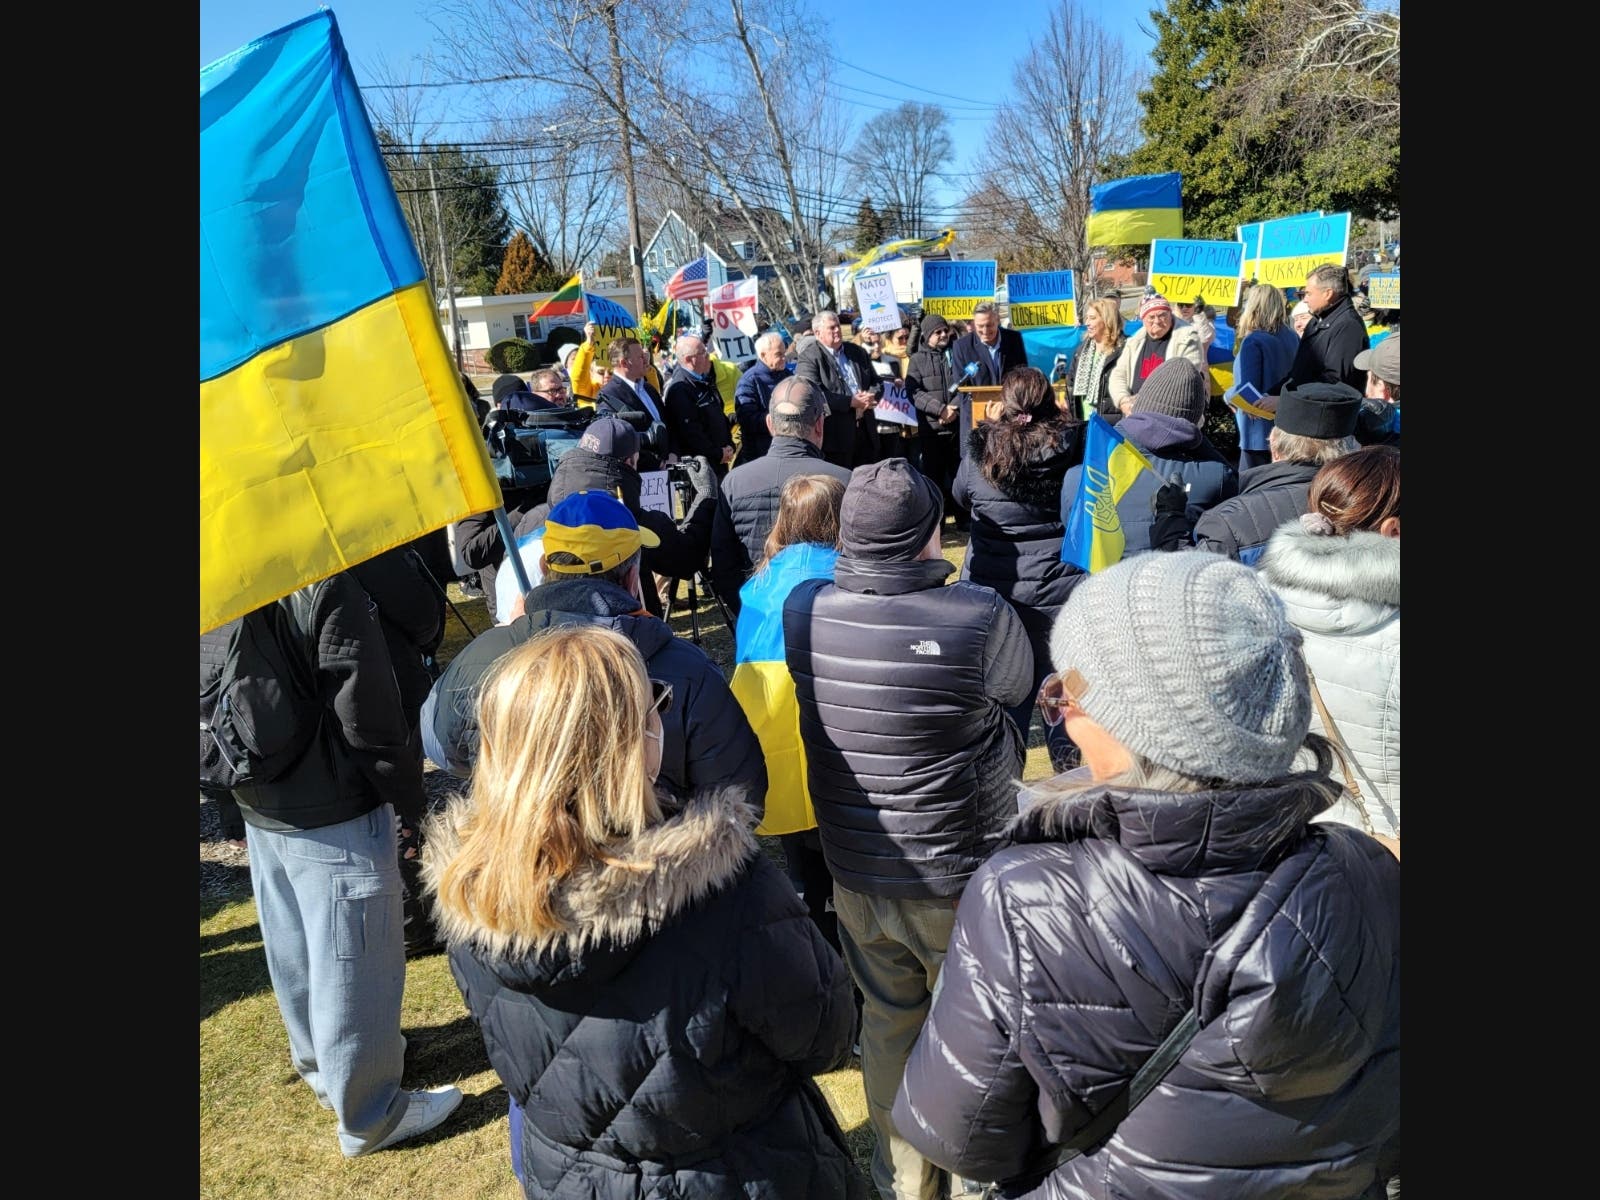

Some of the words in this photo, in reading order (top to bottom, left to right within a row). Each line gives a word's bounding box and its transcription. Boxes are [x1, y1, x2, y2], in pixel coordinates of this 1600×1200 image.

[1269, 222, 1331, 249] STAND
[1161, 245, 1203, 268] STOP
[1204, 246, 1242, 269] PUTIN
[926, 265, 952, 291] STOP
[954, 265, 996, 291] RUSSIAN
[1265, 257, 1330, 281] UKRAIN
[860, 278, 887, 290] NATO
[1008, 274, 1032, 297] SAVE
[1032, 272, 1071, 296] UKRAINE
[1160, 275, 1195, 297] STOP
[925, 299, 974, 316] AGGRESSOR
[1010, 306, 1035, 326] CLOSE
[1034, 305, 1050, 325] THE
[1051, 303, 1069, 325] SKY
[595, 312, 636, 339] WAR
[890, 387, 908, 399] NO
[879, 400, 910, 414] WAR
